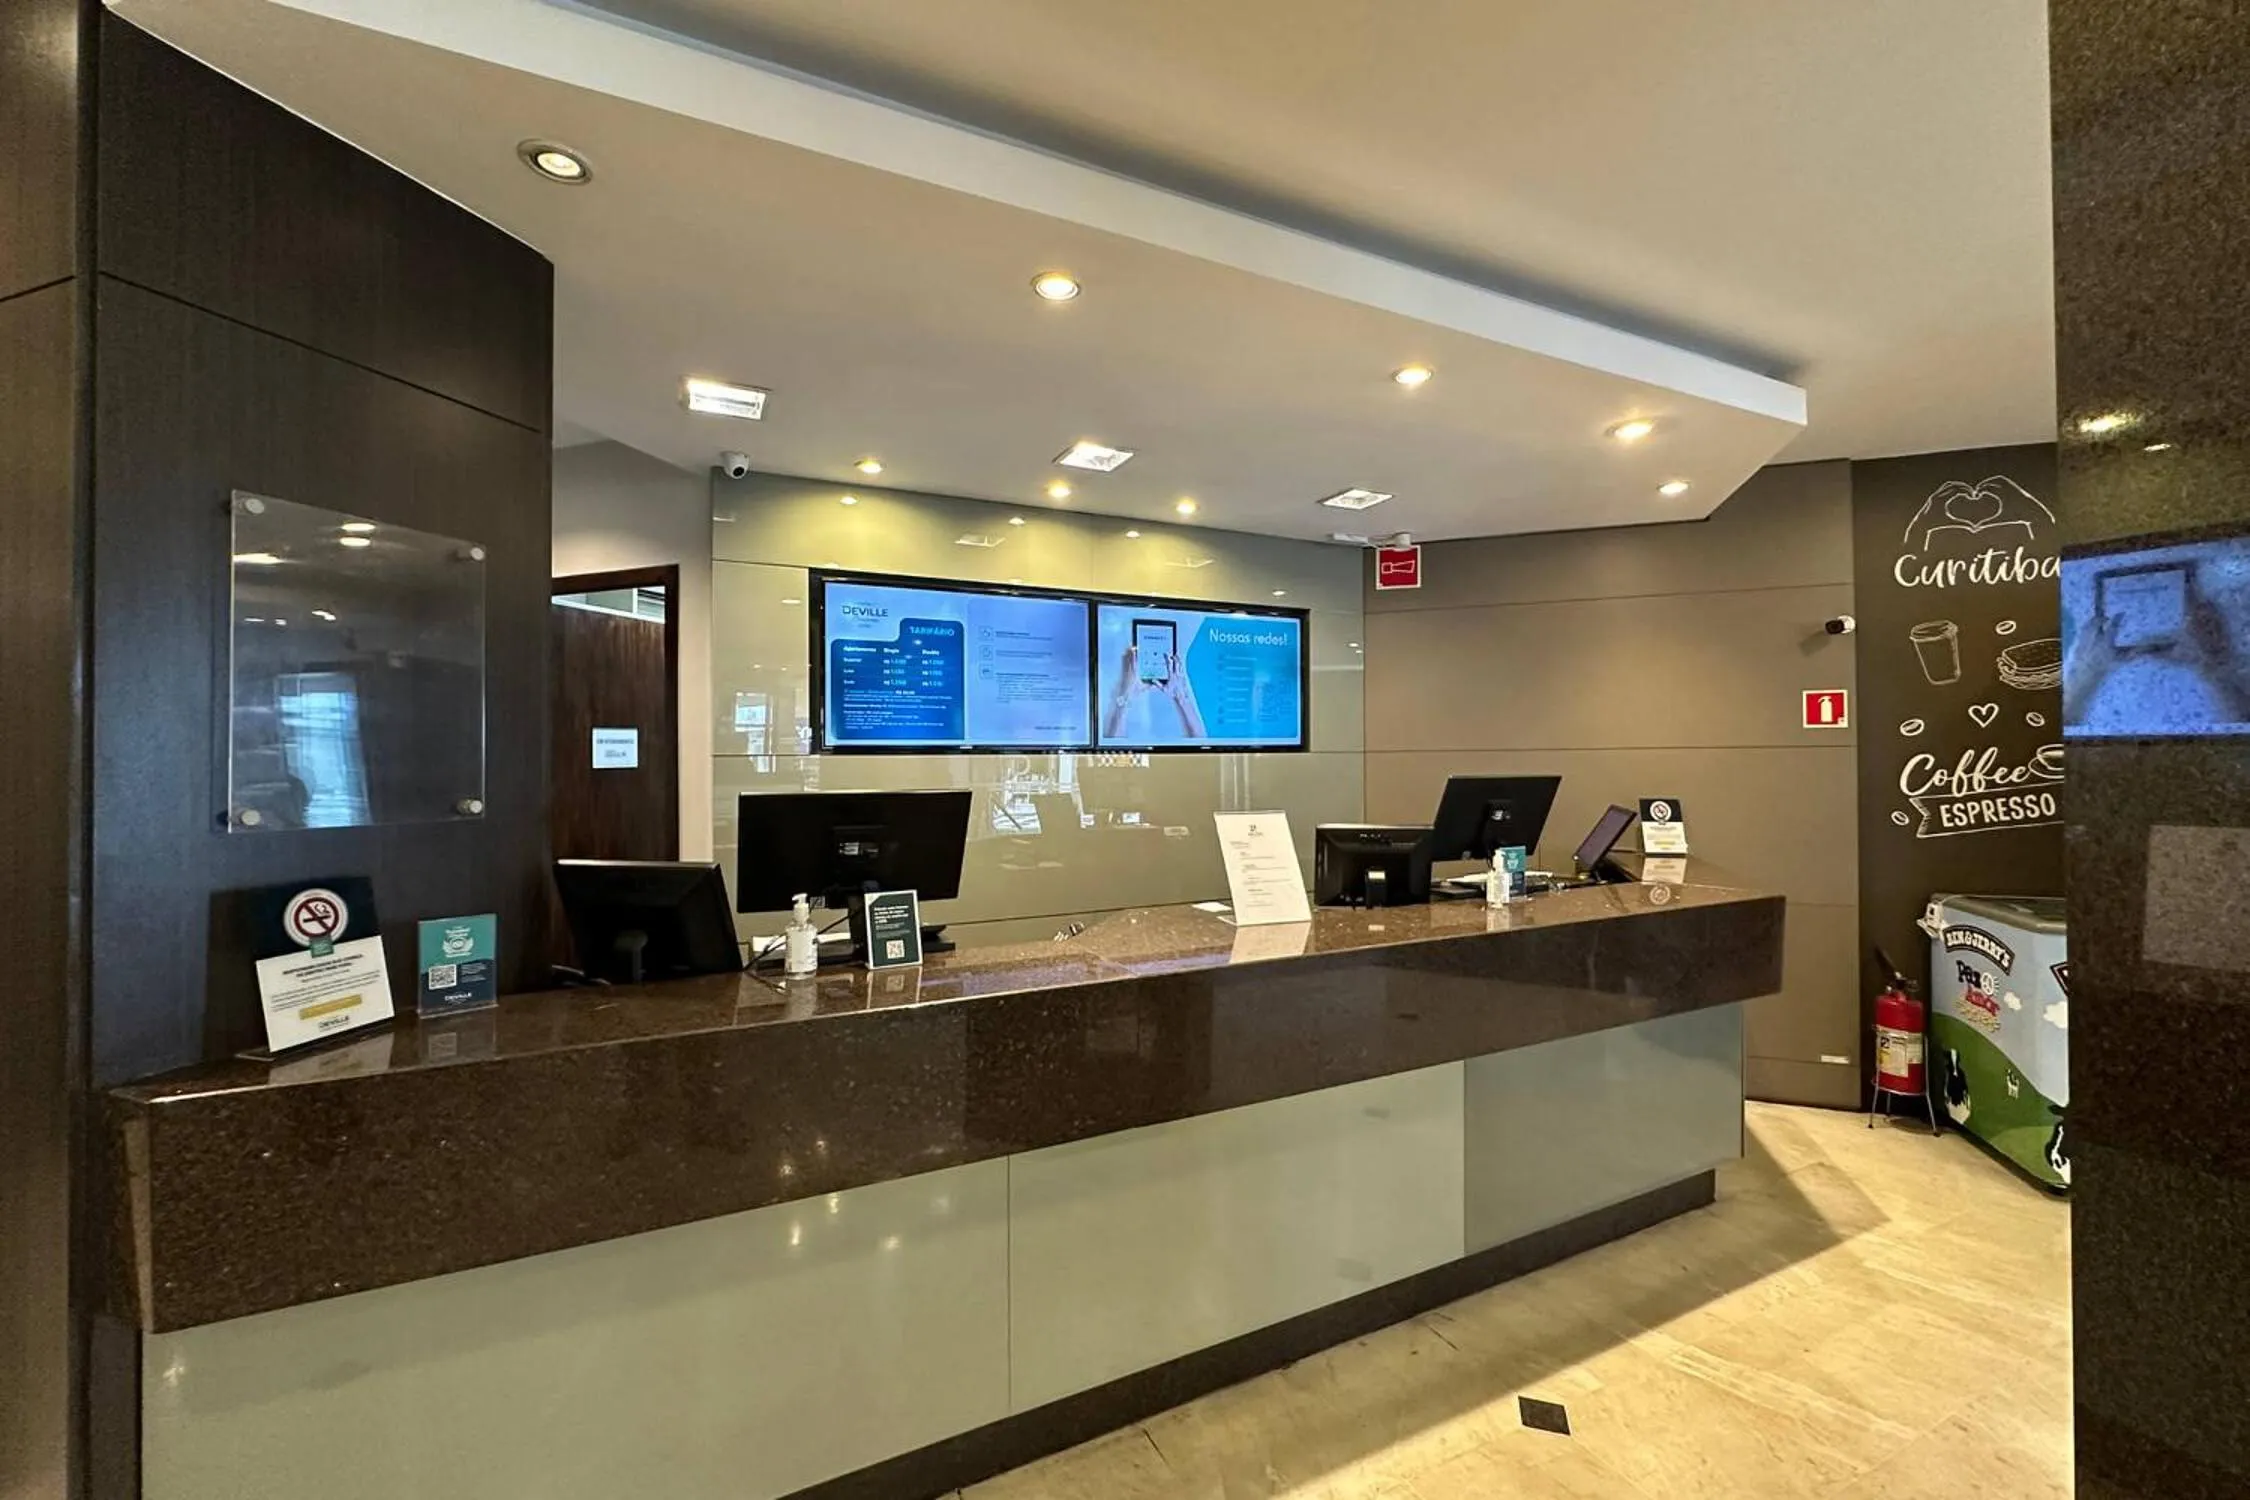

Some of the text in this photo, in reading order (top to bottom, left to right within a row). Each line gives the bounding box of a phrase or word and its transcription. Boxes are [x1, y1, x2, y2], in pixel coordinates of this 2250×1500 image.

[1894, 546, 2062, 588] Curitiba
[842, 605, 889, 617] DEVILLE
[1209, 629, 1288, 646] Nossas redes!
[1899, 746, 2031, 798] Coffee
[1939, 793, 2056, 828] ESPRESSO
